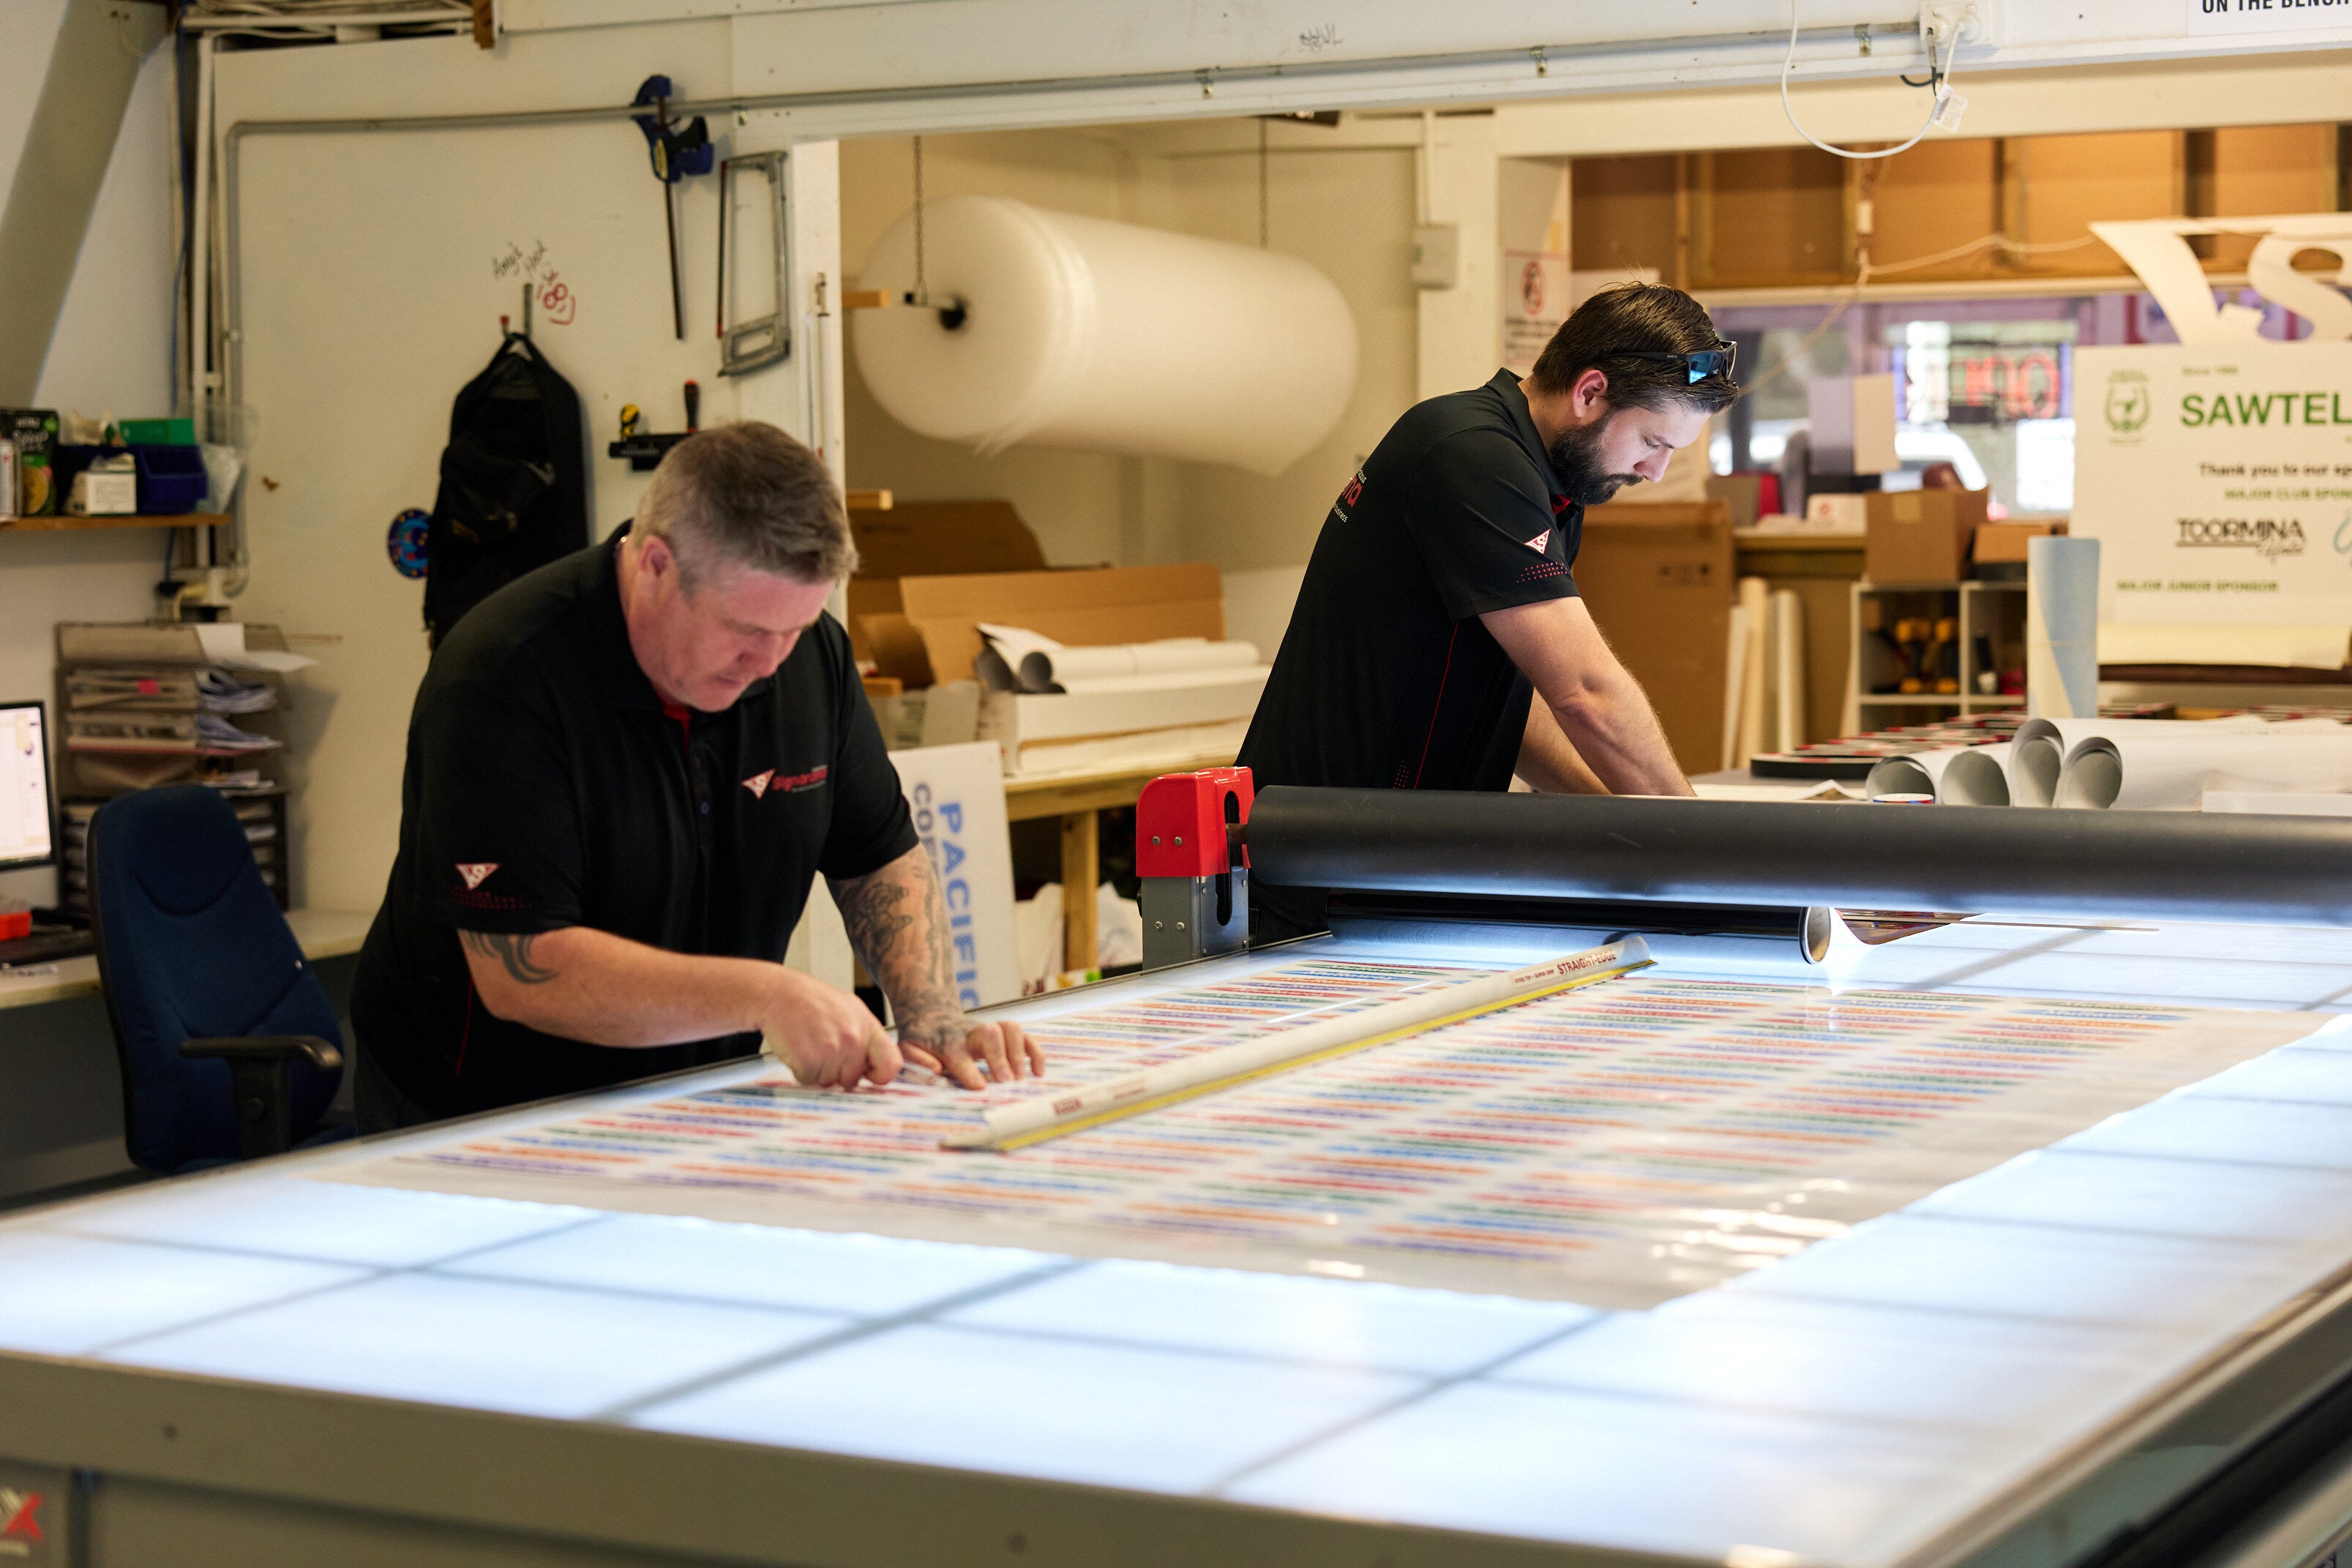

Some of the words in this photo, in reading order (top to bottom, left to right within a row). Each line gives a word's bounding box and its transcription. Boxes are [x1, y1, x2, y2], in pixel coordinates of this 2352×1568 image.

[2180, 392, 2352, 427] SAWTEL
[2199, 462, 2245, 476] Thank
[2251, 465, 2278, 480] you
[2283, 463, 2299, 476] to
[2303, 465, 2329, 476] our
[2224, 488, 2272, 500] MAJOR
[2277, 488, 2310, 500] CLUB
[2176, 517, 2304, 539] TOORMINA
[2117, 580, 2162, 592] MAJOR
[2216, 580, 2278, 592] SPONSOR
[1557, 950, 1617, 975] STRAIGHT-EDGE
